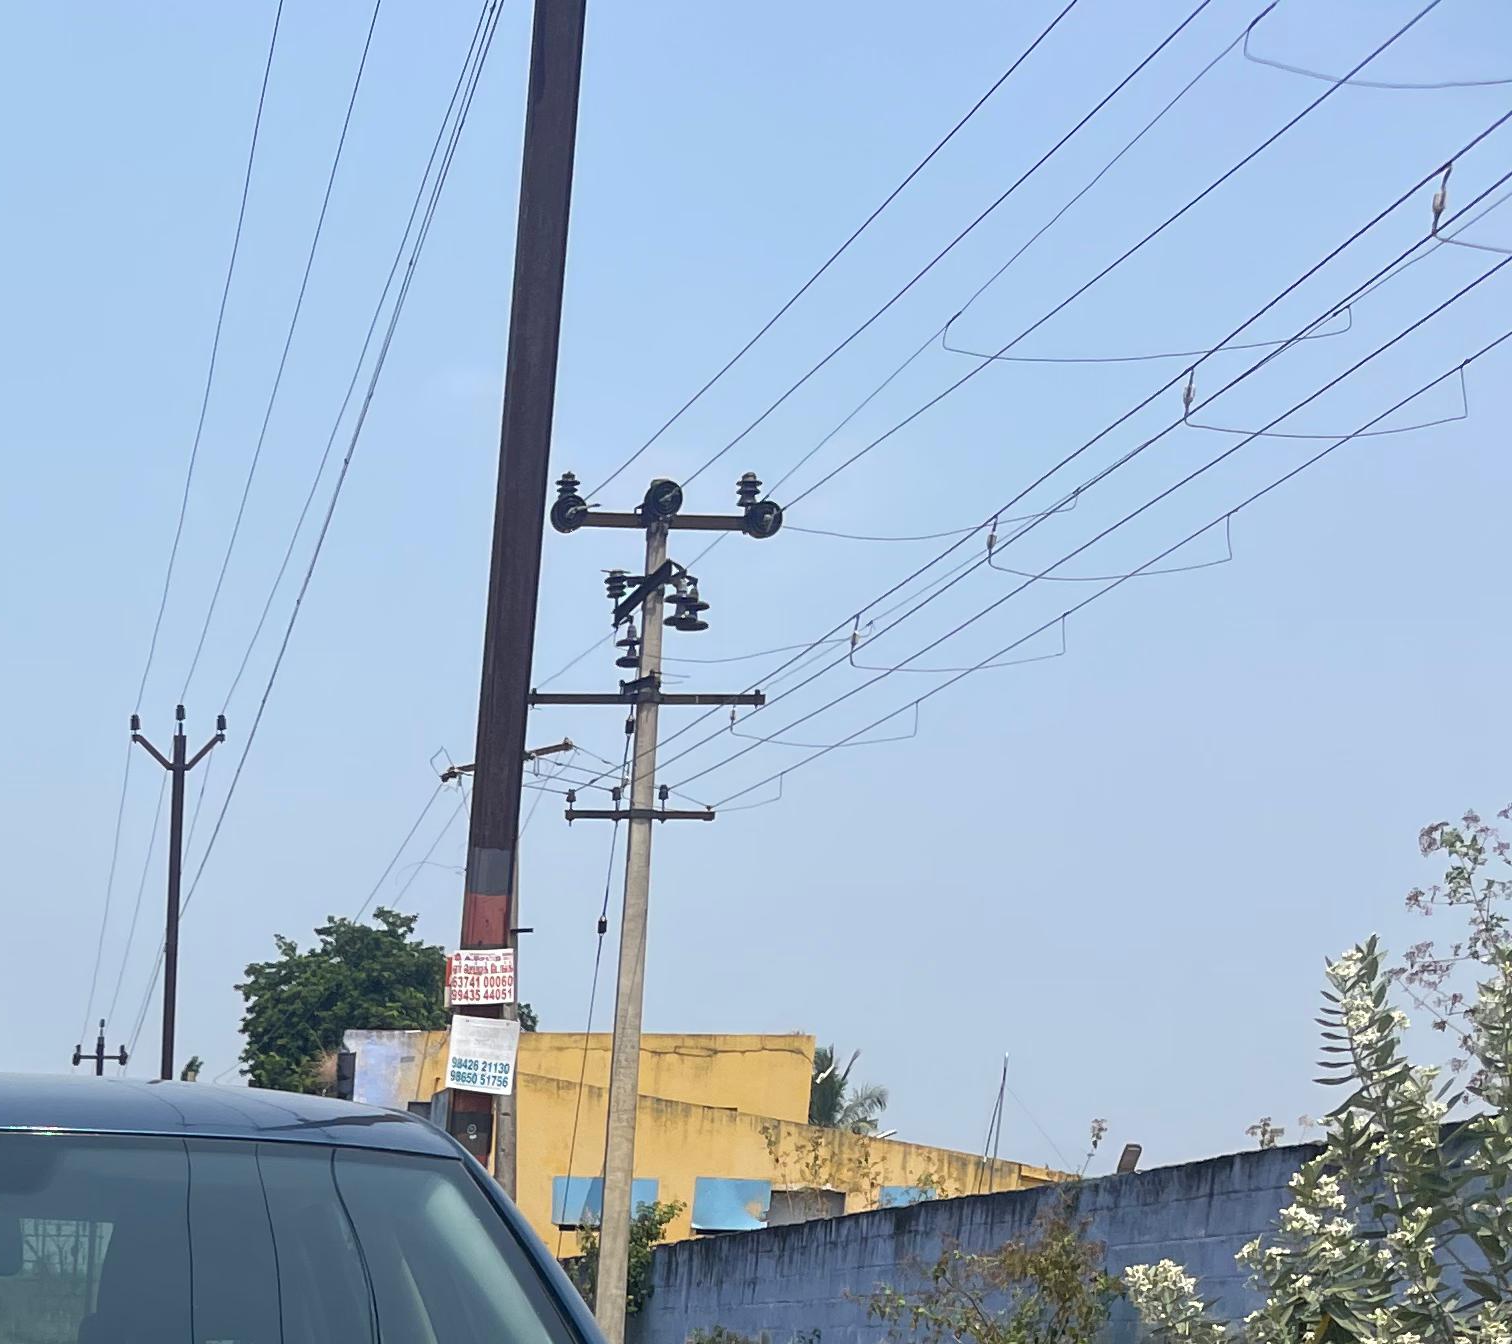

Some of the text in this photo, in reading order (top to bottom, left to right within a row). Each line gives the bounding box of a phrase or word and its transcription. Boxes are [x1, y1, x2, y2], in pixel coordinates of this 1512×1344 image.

[451, 975, 513, 988] 63741 00060
[451, 988, 512, 1001] 99435 44051
[451, 1056, 510, 1075] 98426 21130
[480, 1073, 509, 1088] 51756
